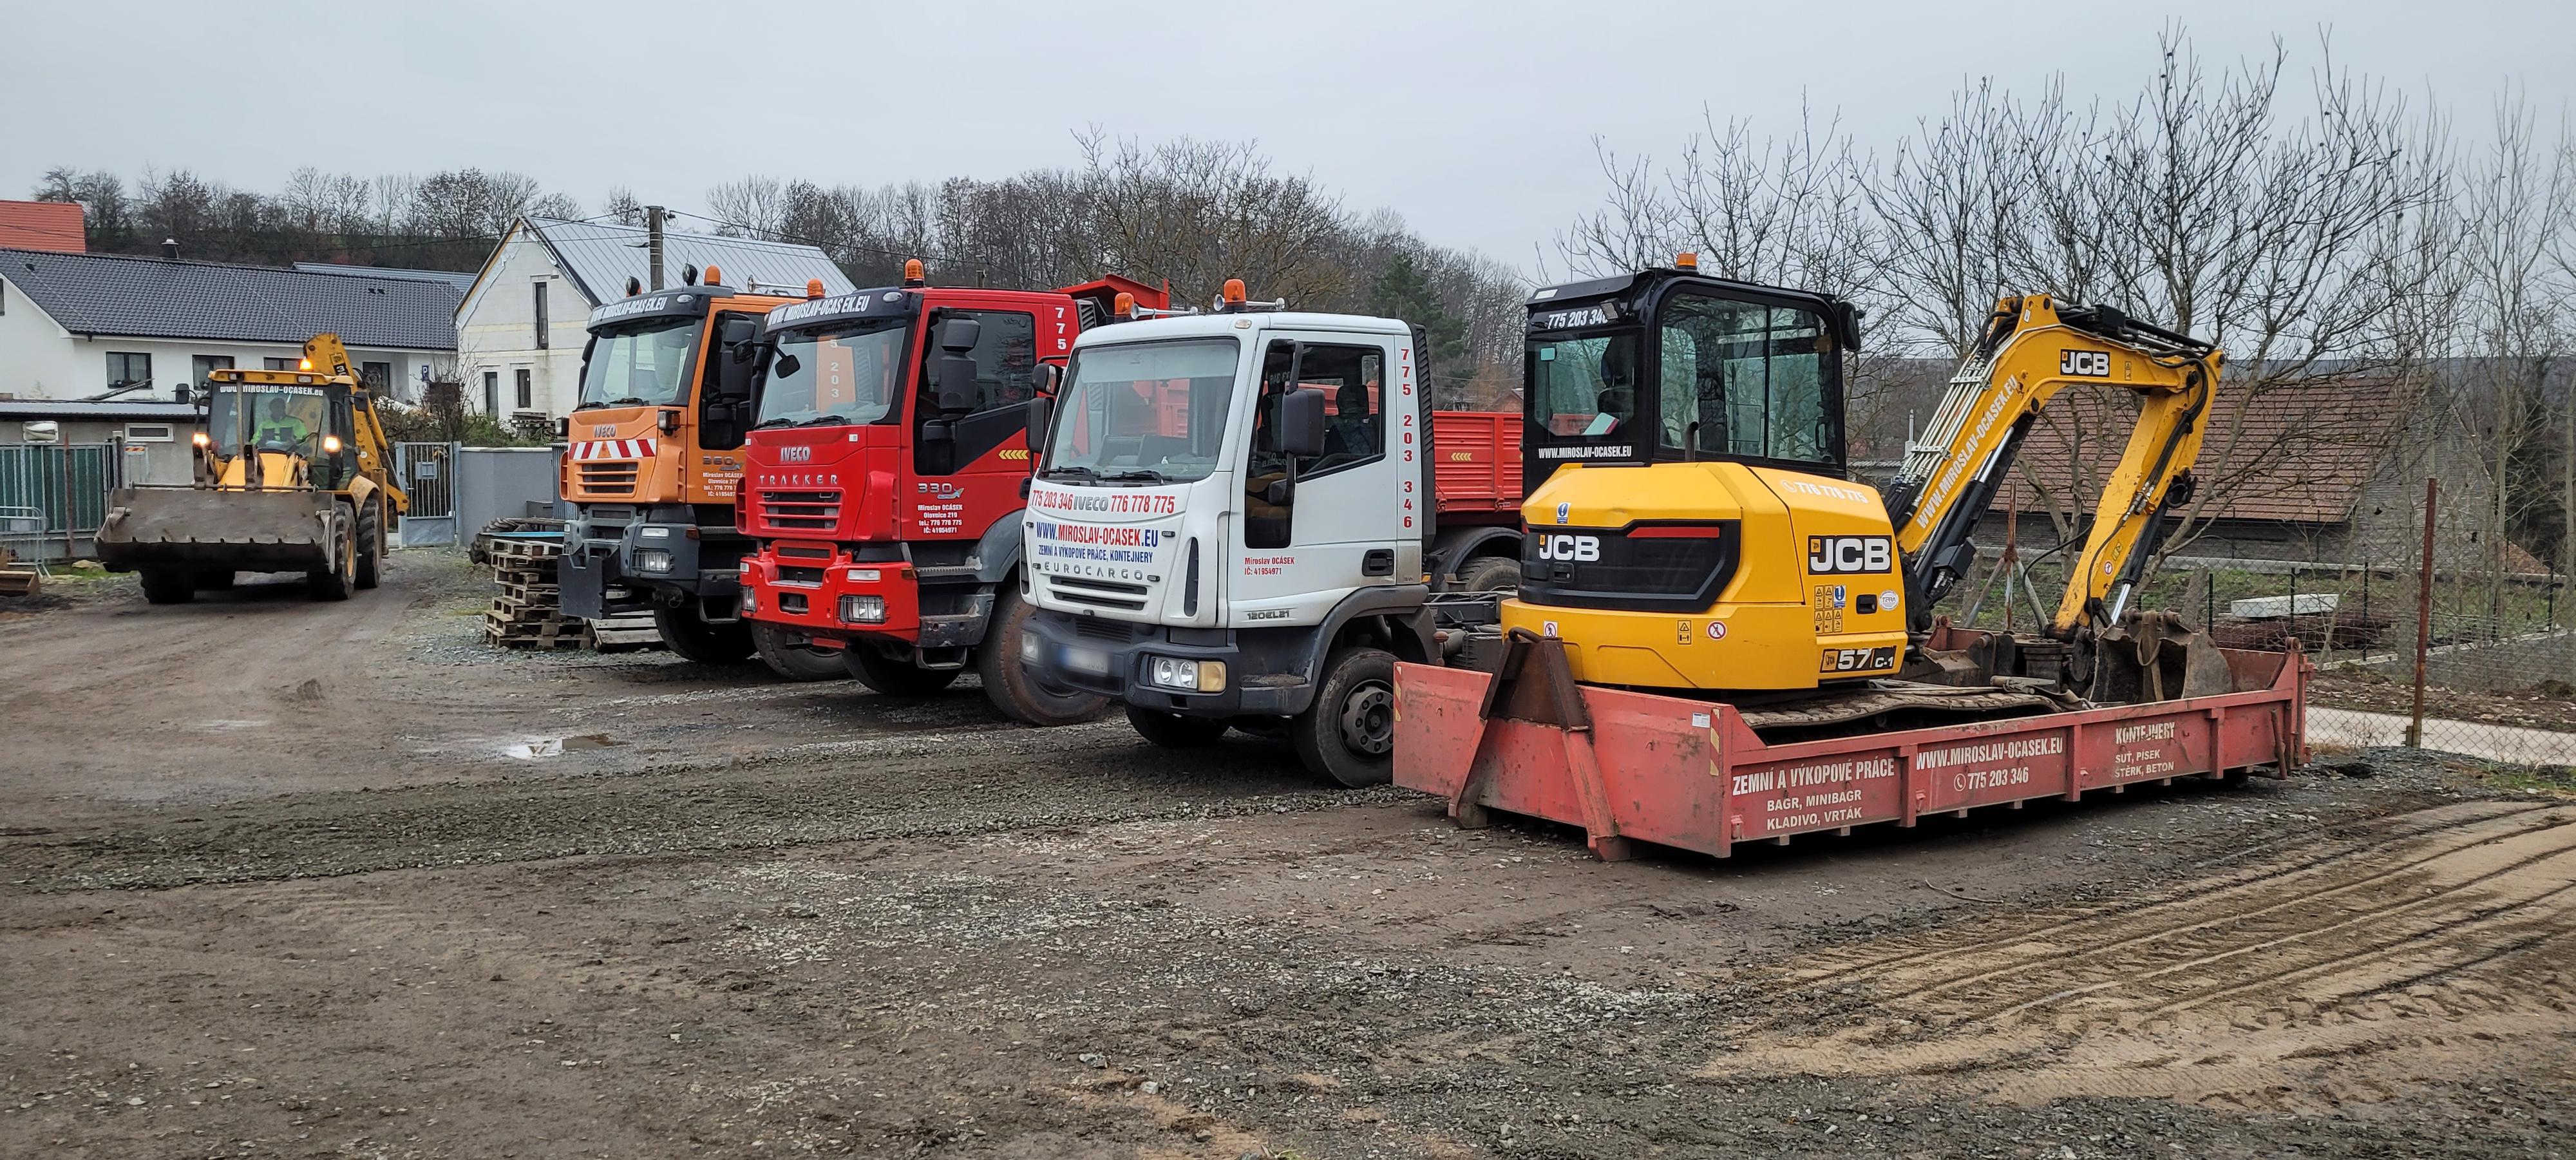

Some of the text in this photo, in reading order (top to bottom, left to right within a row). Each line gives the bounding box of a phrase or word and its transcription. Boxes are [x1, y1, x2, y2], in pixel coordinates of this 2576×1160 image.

[1548, 312, 1567, 329] 775
[1567, 309, 1588, 327] 203
[2061, 351, 2109, 375] JCB
[594, 424, 616, 438] IVECO
[781, 446, 810, 462] IVECO
[1539, 446, 1632, 459] WWW.MIROSLAV-OCASEK.EU
[1916, 374, 2018, 529] WWW.MIROSLAV-OCASEK.EU
[760, 475, 837, 485] TRAKKER
[918, 483, 952, 493] 330
[1031, 490, 1074, 510] 775 203 346
[1794, 481, 1821, 495] 776
[1842, 489, 1868, 504] 775
[1074, 496, 1108, 511] IVECO
[1111, 495, 1175, 514] 776 778 775
[1036, 521, 1159, 547] WWW.MIROSLAV-OCASEK.EU
[1038, 544, 1153, 564] ZEMNÍ A VÝKOPOVÉ PRÁCE, KONTEJNERY
[1539, 535, 1600, 562] JCB
[1810, 538, 1891, 571] JCB
[1044, 561, 1143, 580] EUROCARGO
[1244, 566, 1253, 575] IČ:
[1271, 556, 1294, 565] OCÁSEK
[1837, 648, 1872, 670] 57
[1875, 656, 1893, 667] C-1
[1916, 737, 2063, 770] WWW.MIROSLAV-OCASEK.EU
[2115, 748, 2161, 764] SUŤ, PÍSEK
[1732, 756, 1895, 796] ZEMNÍ A VÝKOPOVÉ PRÁCE
[2146, 761, 2174, 774] BETON
[1967, 766, 2029, 790] 775 203 346
[1766, 789, 1862, 812] BAGR, MINIBAGR
[1766, 806, 1862, 831] KLADIVO, VRTÁK
